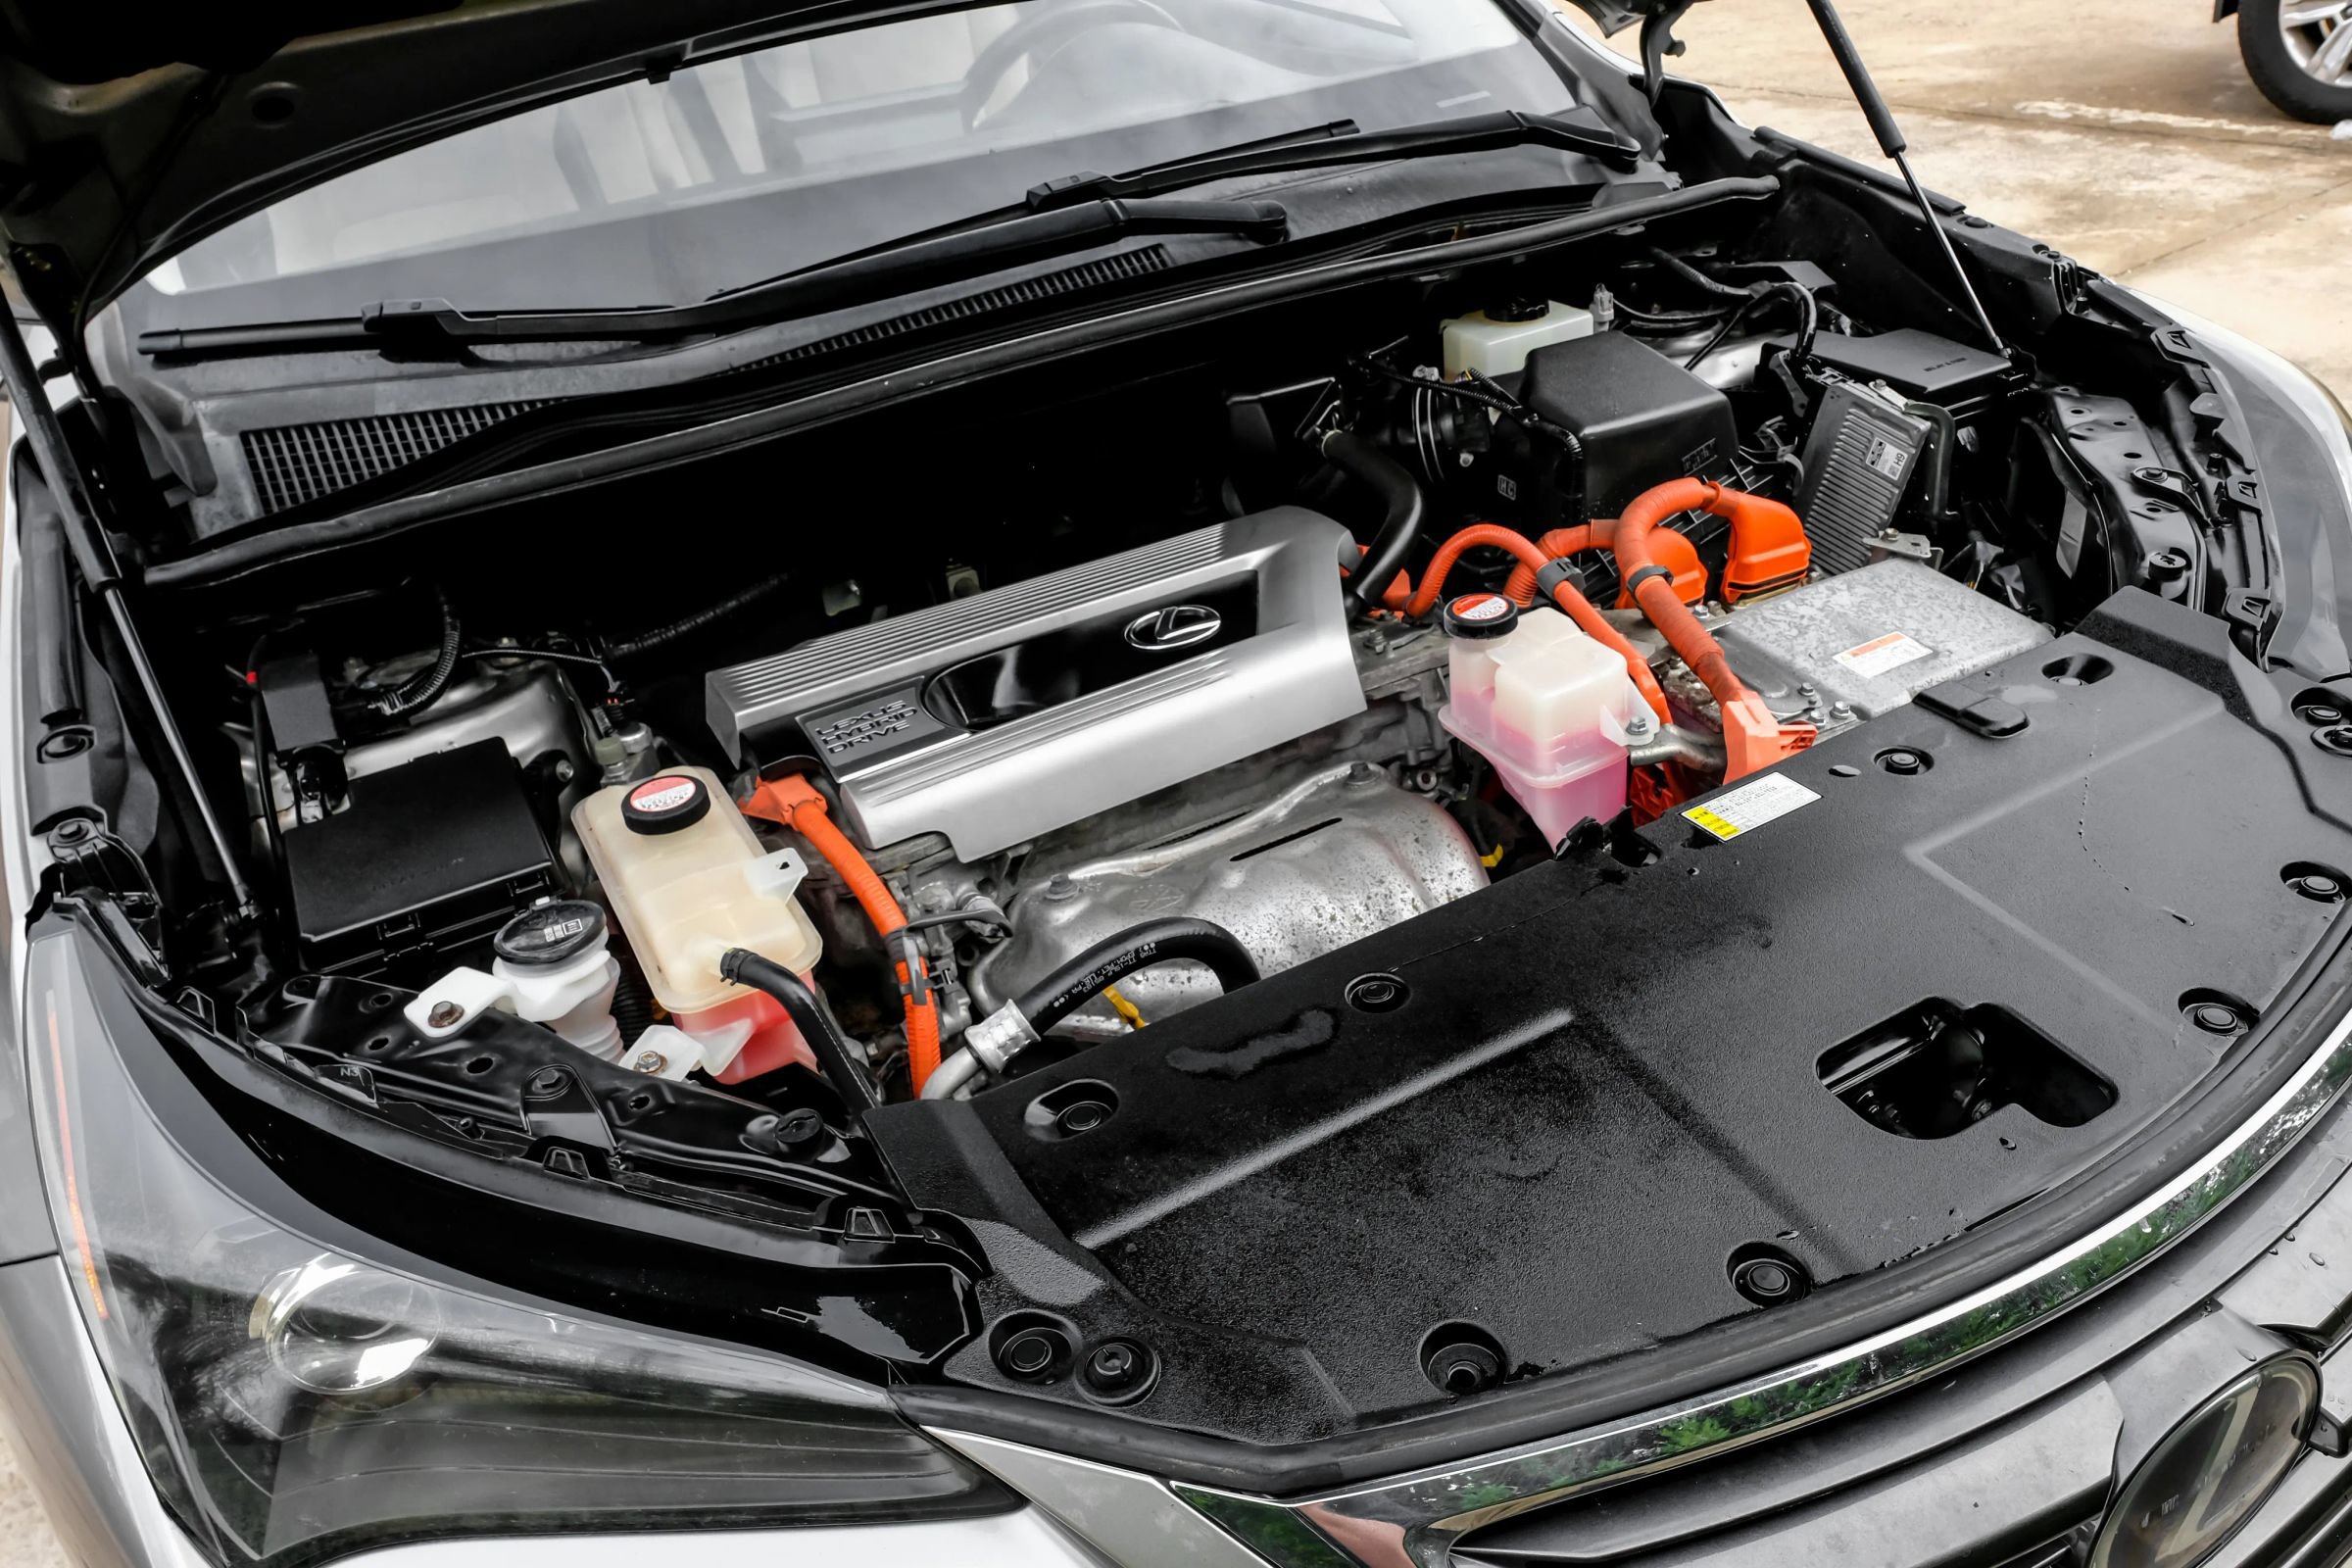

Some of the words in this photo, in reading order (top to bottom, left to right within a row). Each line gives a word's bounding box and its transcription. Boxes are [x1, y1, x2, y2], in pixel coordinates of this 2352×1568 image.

[815, 700, 907, 735] LEXUS
[821, 707, 918, 744] HYBRID
[827, 720, 910, 754] DRIVE
